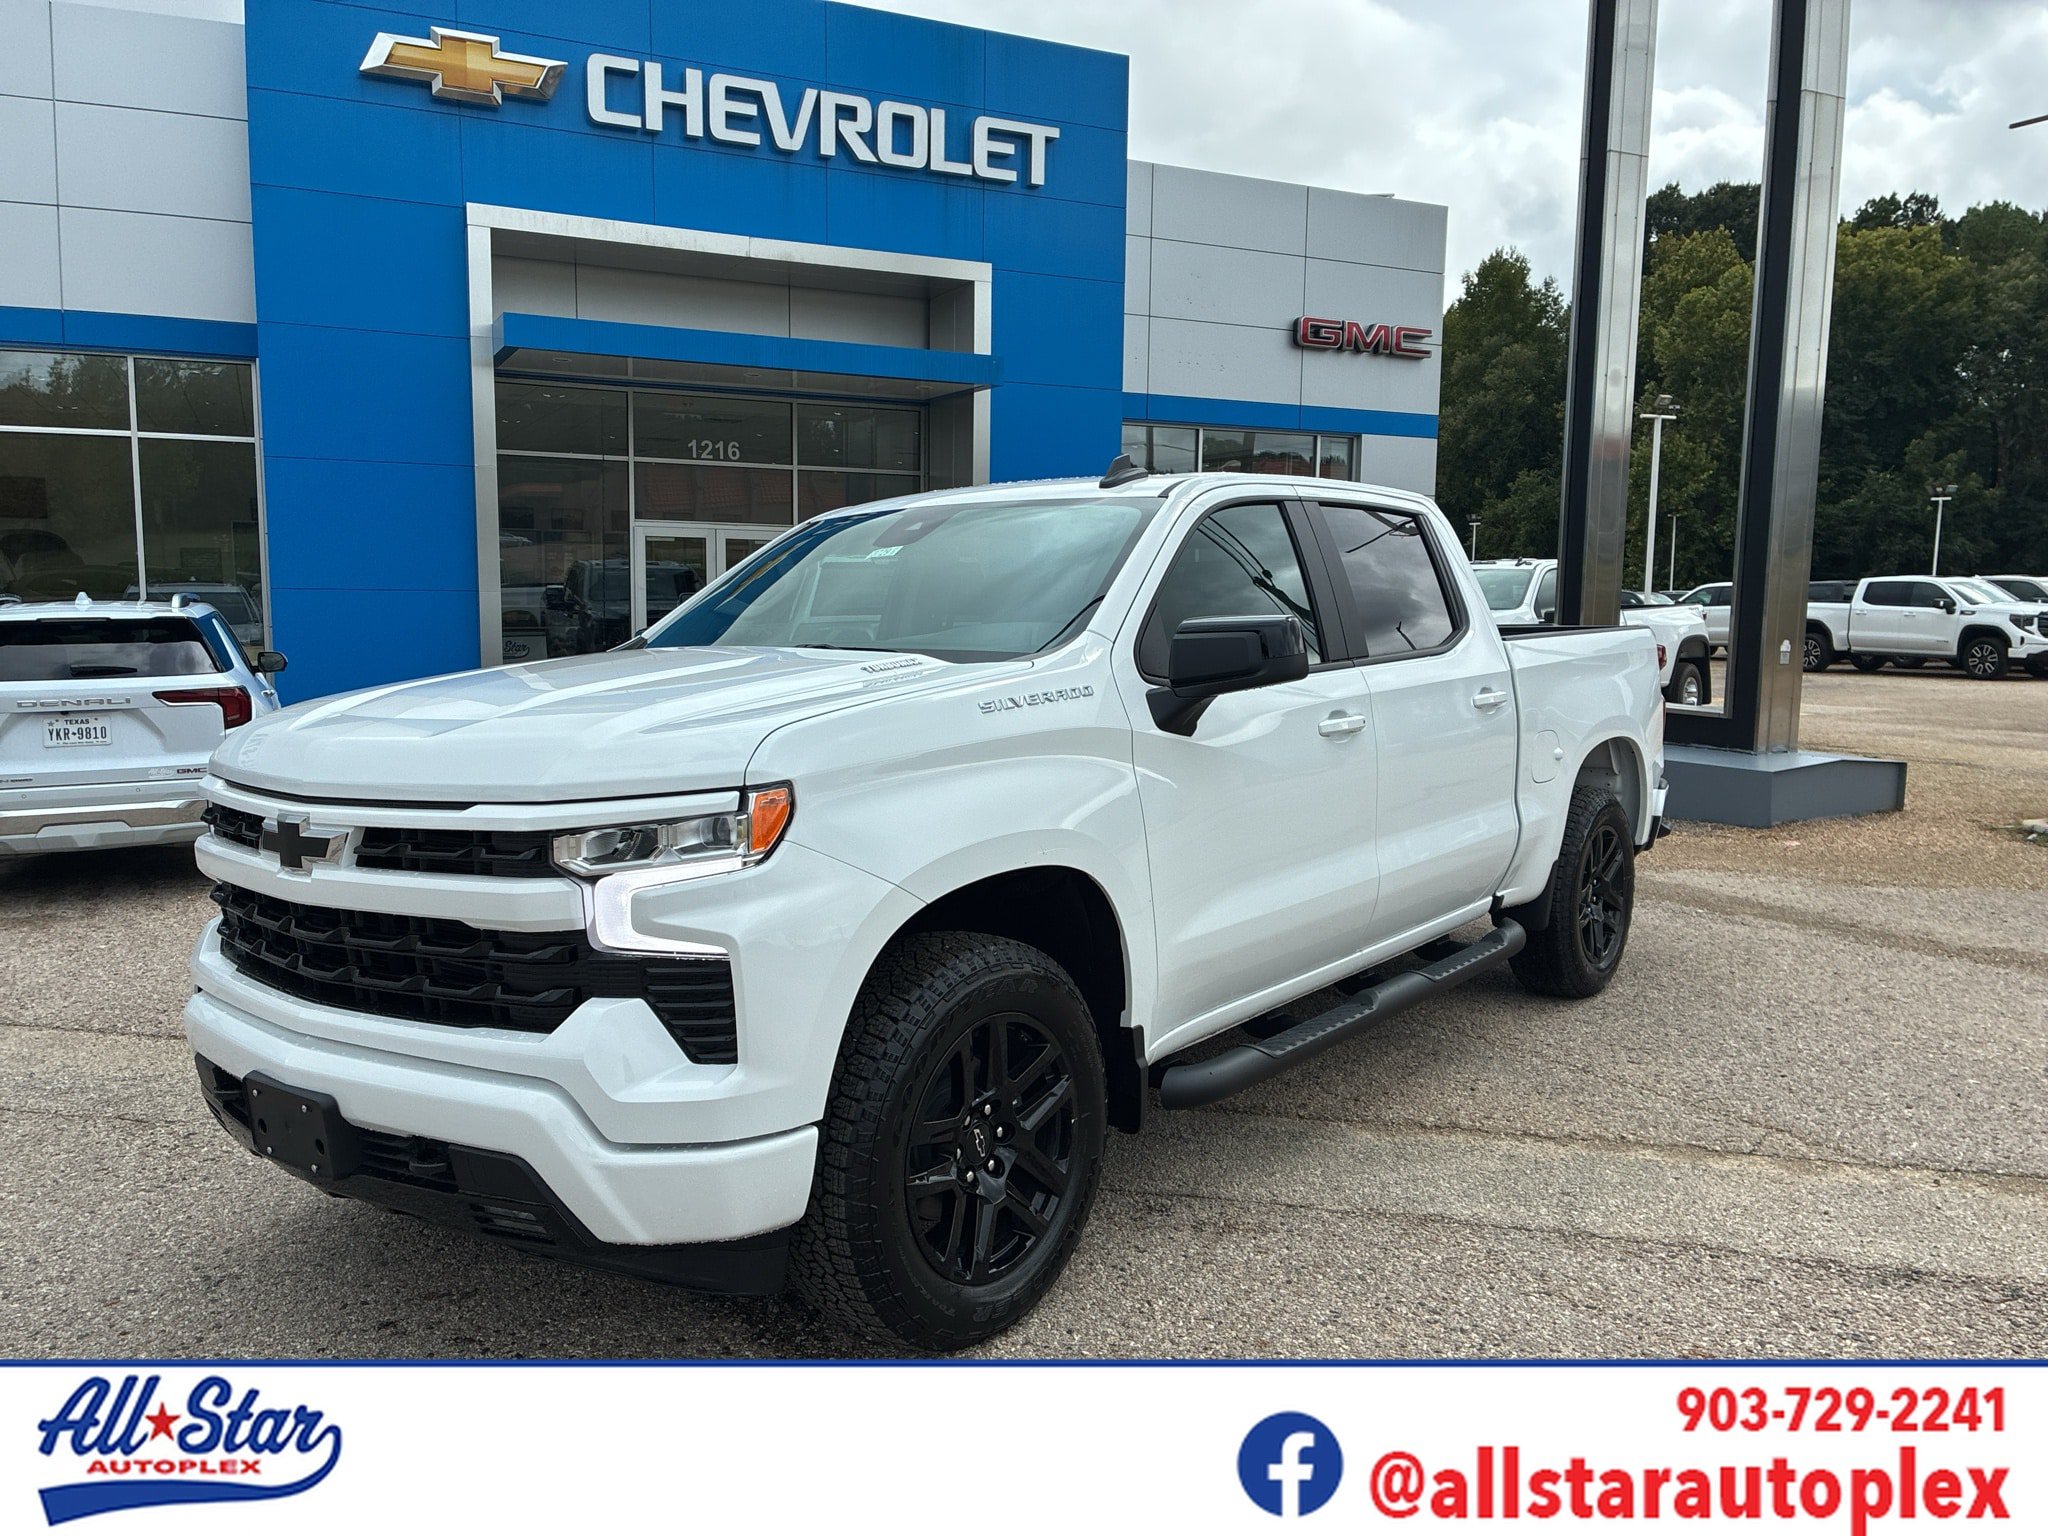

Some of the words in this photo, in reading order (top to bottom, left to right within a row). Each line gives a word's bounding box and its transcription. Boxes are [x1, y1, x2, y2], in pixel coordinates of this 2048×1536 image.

[586, 52, 1061, 187] CHEVROLET
[1294, 315, 1433, 359] GMC
[687, 439, 740, 460] 1216
[16, 697, 131, 709] DENALI
[978, 685, 1095, 714] SILVERADO
[176, 767, 208, 775] GMC
